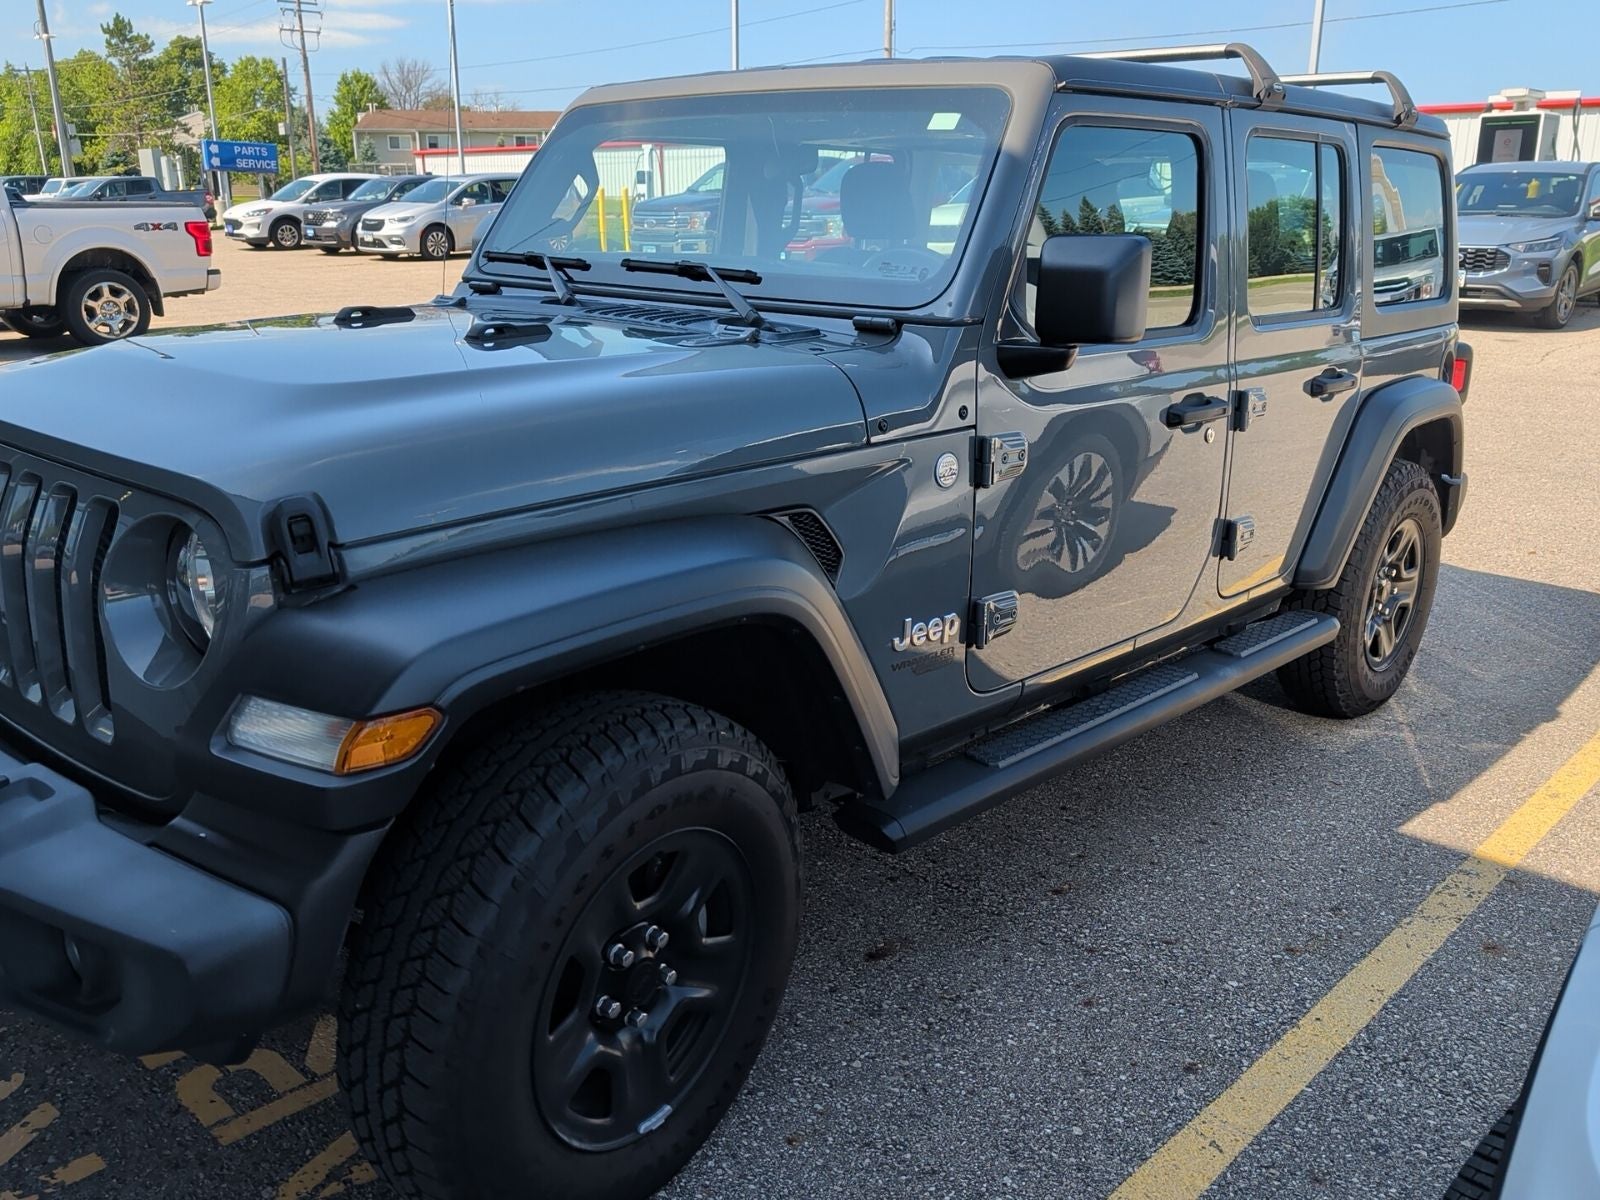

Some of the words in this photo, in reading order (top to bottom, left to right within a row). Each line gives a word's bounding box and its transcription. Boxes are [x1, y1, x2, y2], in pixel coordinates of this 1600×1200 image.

[234, 146, 268, 156] PARTS
[236, 159, 278, 169] SERVICE
[893, 612, 961, 652] Jeep
